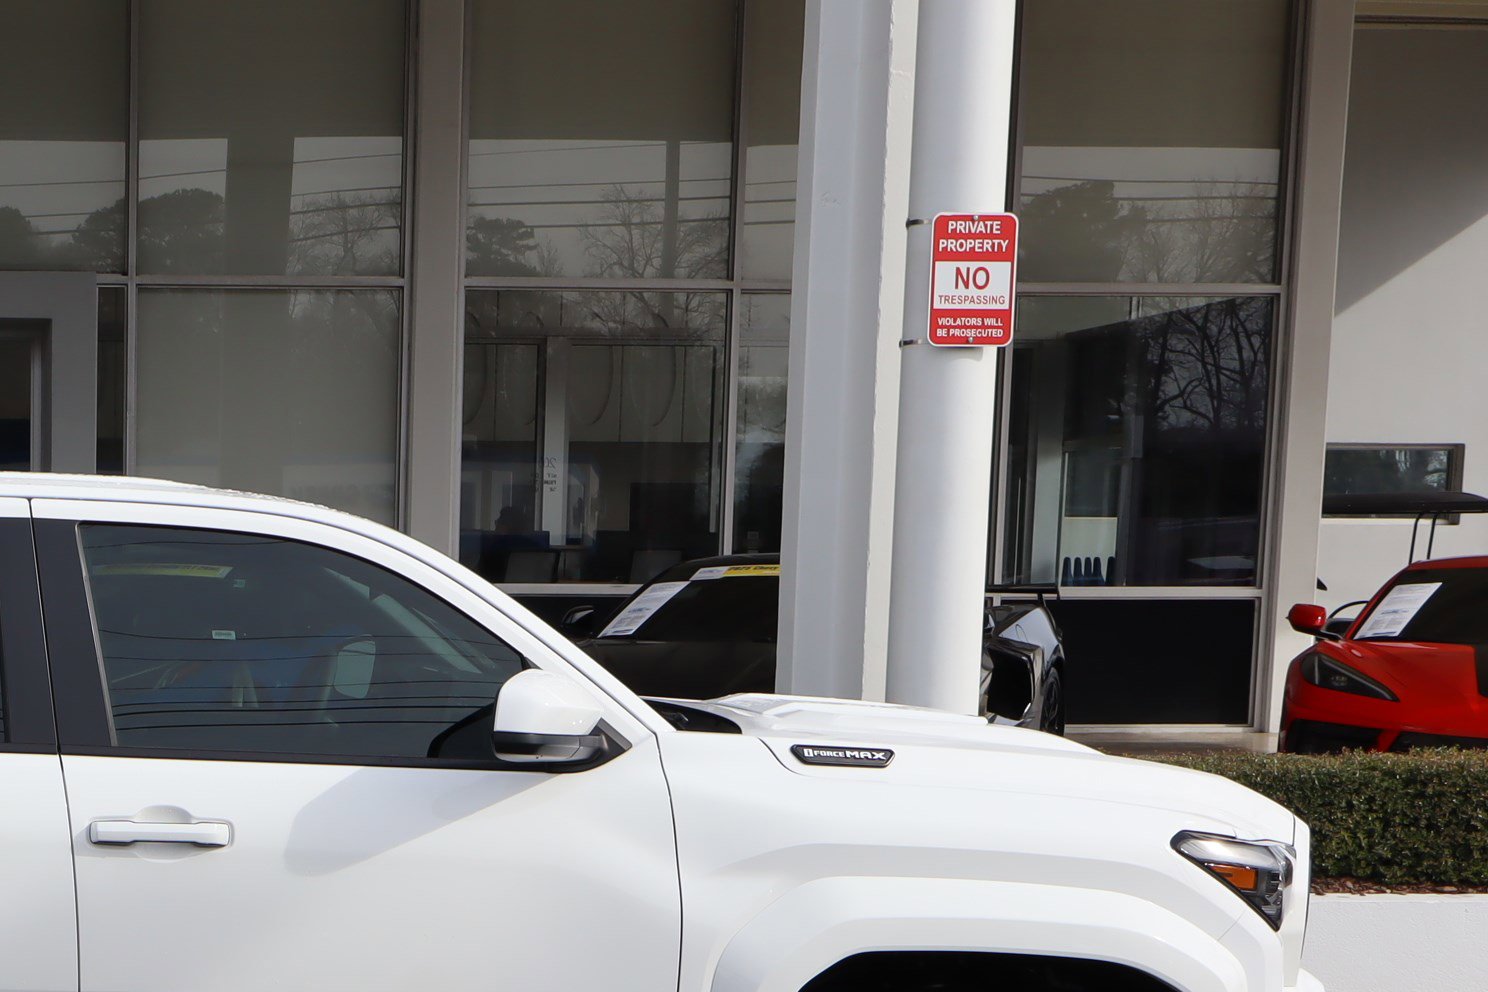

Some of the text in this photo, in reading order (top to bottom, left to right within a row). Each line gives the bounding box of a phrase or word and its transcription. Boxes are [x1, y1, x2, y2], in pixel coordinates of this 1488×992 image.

[948, 220, 1002, 234] PRIVATE
[938, 239, 1009, 252] PROPERTY
[954, 266, 991, 290] NO
[938, 294, 1006, 305] TRESPASSING
[937, 317, 1003, 326] VIOLATORS WILL
[936, 328, 1004, 338] BE PROSECUTED
